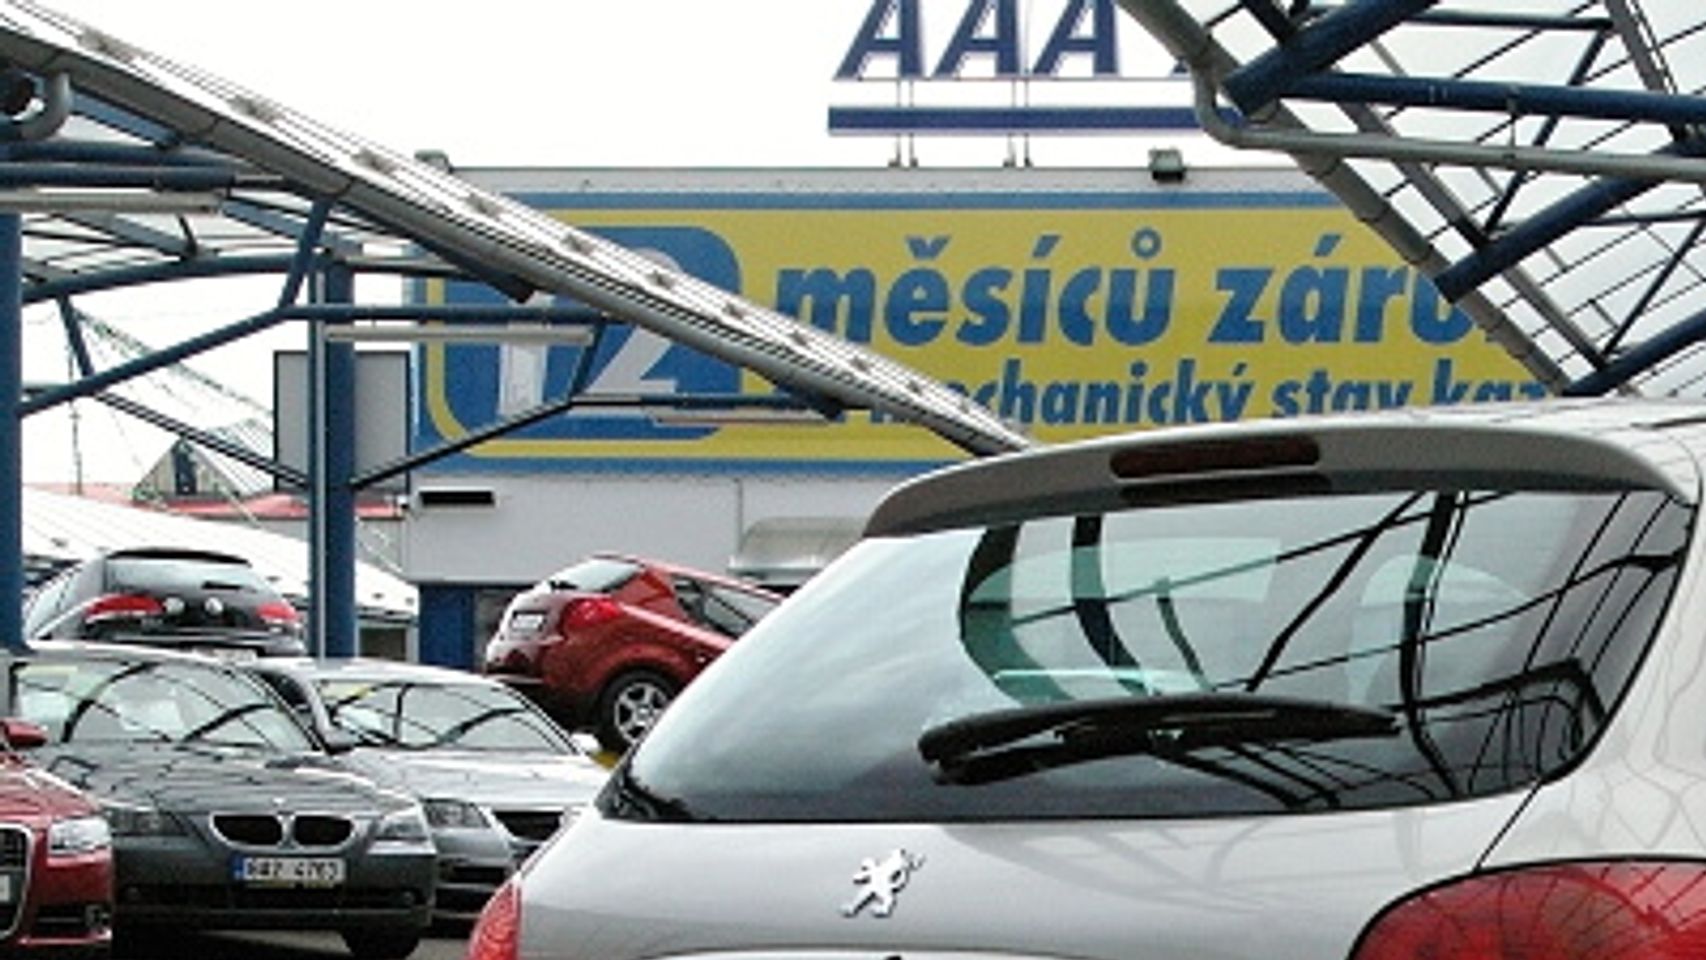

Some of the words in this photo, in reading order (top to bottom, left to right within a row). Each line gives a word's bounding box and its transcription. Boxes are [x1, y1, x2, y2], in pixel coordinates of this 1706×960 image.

[833, 0, 1118, 77] AAA
[776, 229, 1176, 347] měsíců
[1208, 234, 1500, 344] záru
[1272, 368, 1414, 418] stav
